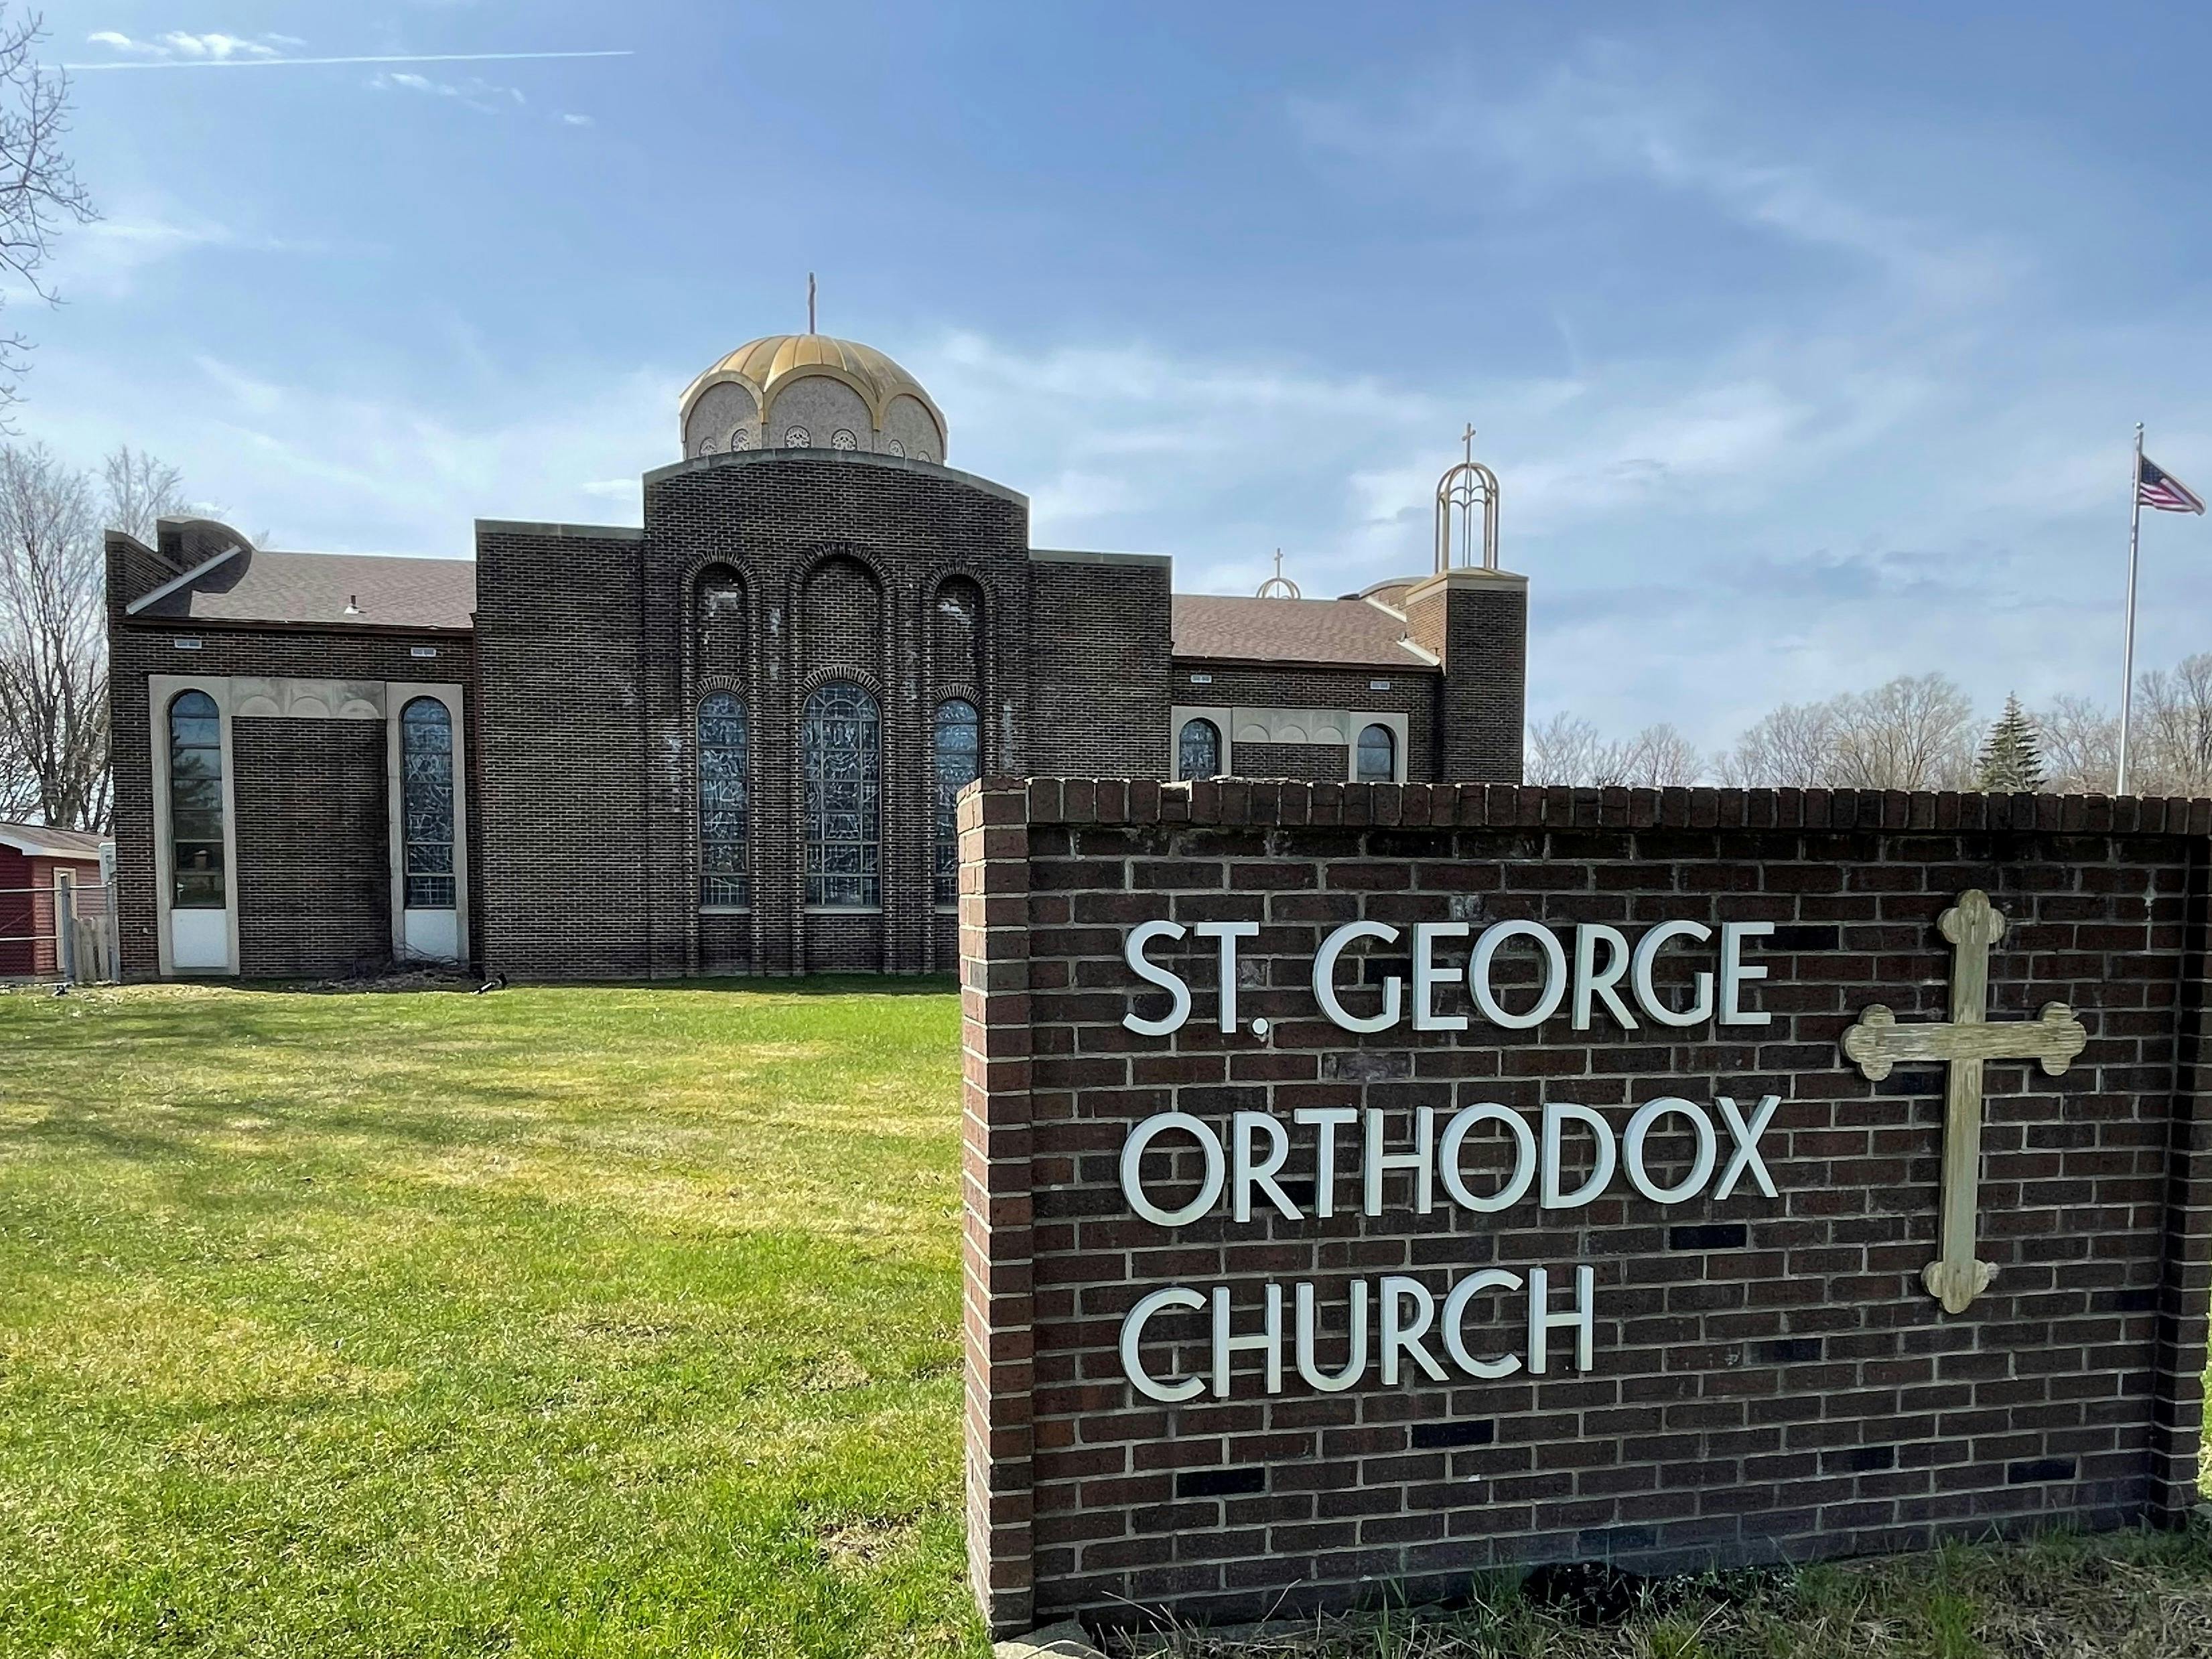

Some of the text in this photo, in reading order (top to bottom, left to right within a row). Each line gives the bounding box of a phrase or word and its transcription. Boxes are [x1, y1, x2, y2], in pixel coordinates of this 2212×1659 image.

[1121, 920, 1775, 1036] ST. GEORGE
[1119, 1095, 1781, 1227] ORTHODOX
[1119, 1265, 1594, 1402] CHURCH
